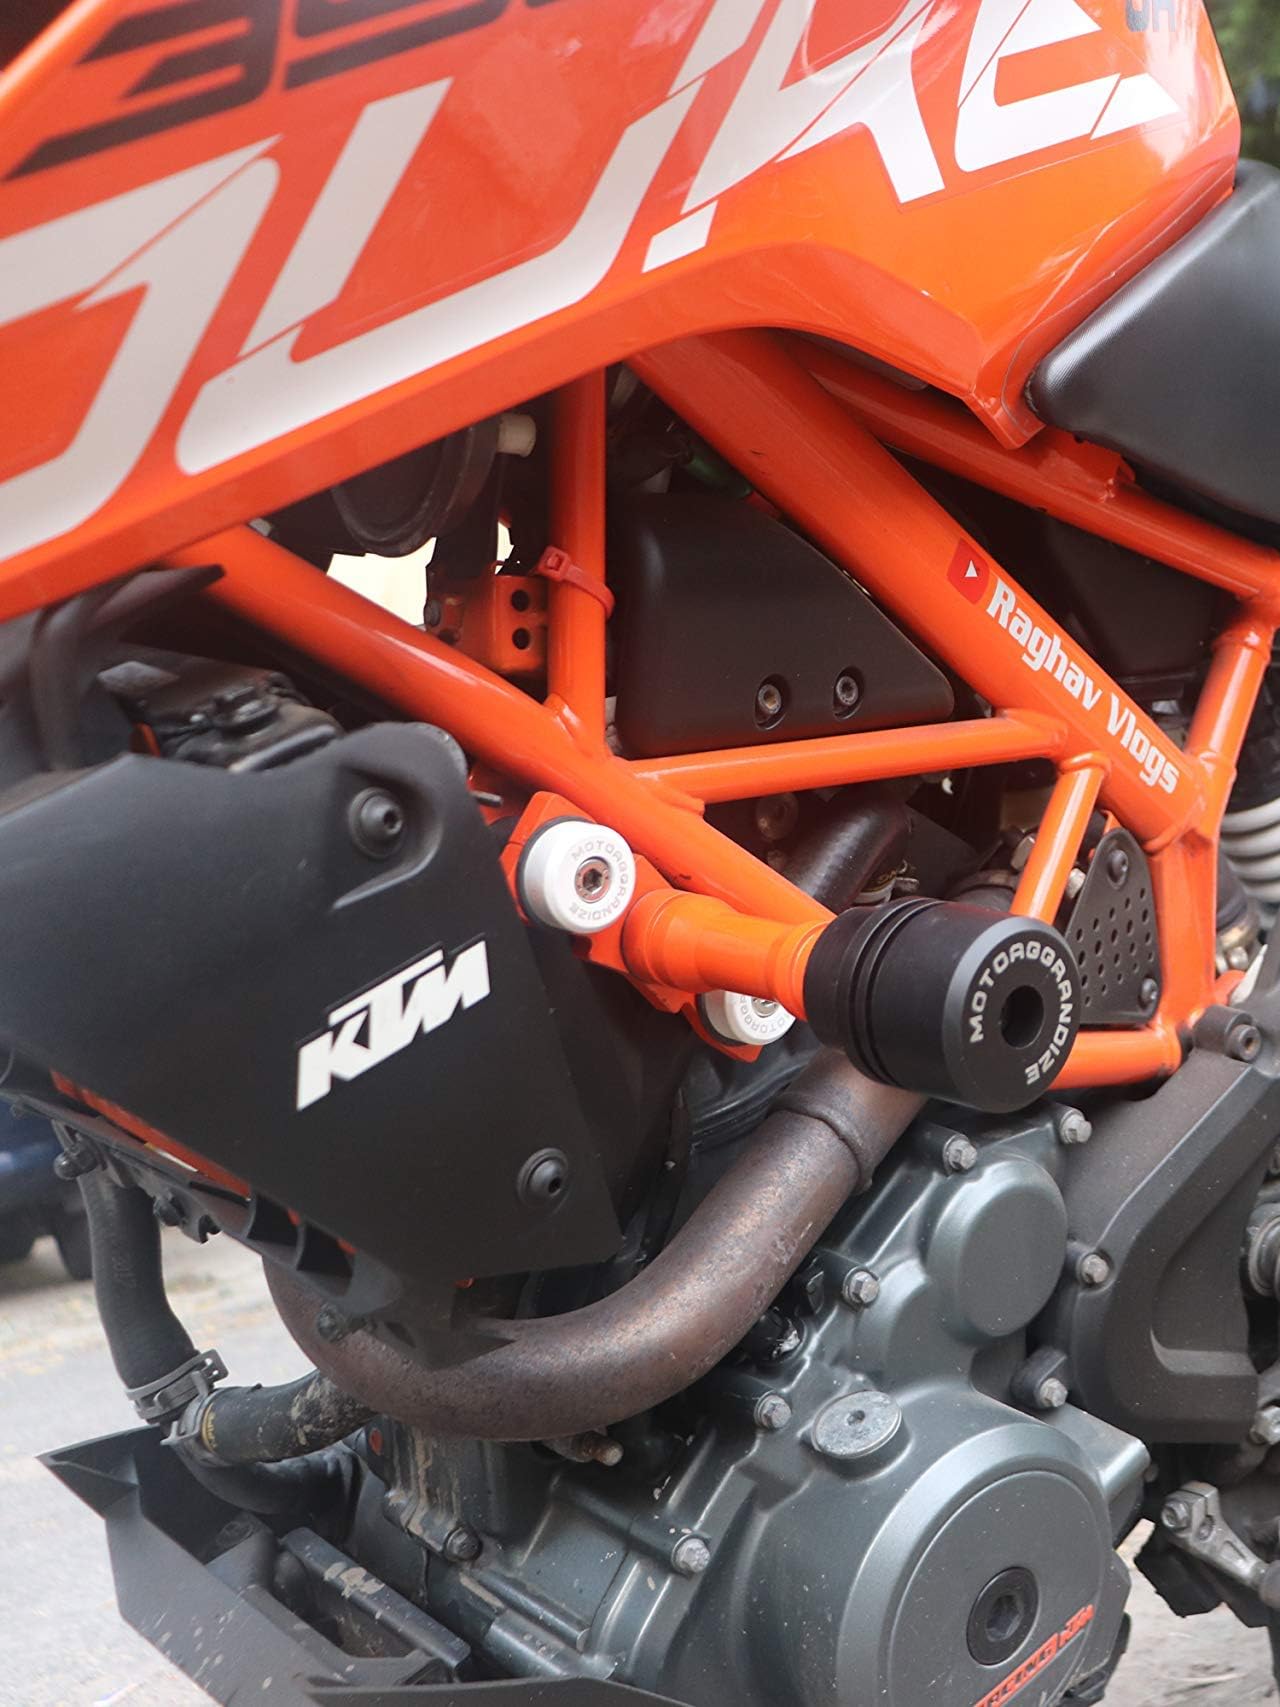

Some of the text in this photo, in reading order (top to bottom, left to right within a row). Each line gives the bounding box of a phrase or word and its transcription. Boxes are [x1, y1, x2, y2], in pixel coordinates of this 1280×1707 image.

[986, 577, 1180, 793] Raghav Vlogs
[296, 940, 490, 1111] KTM
